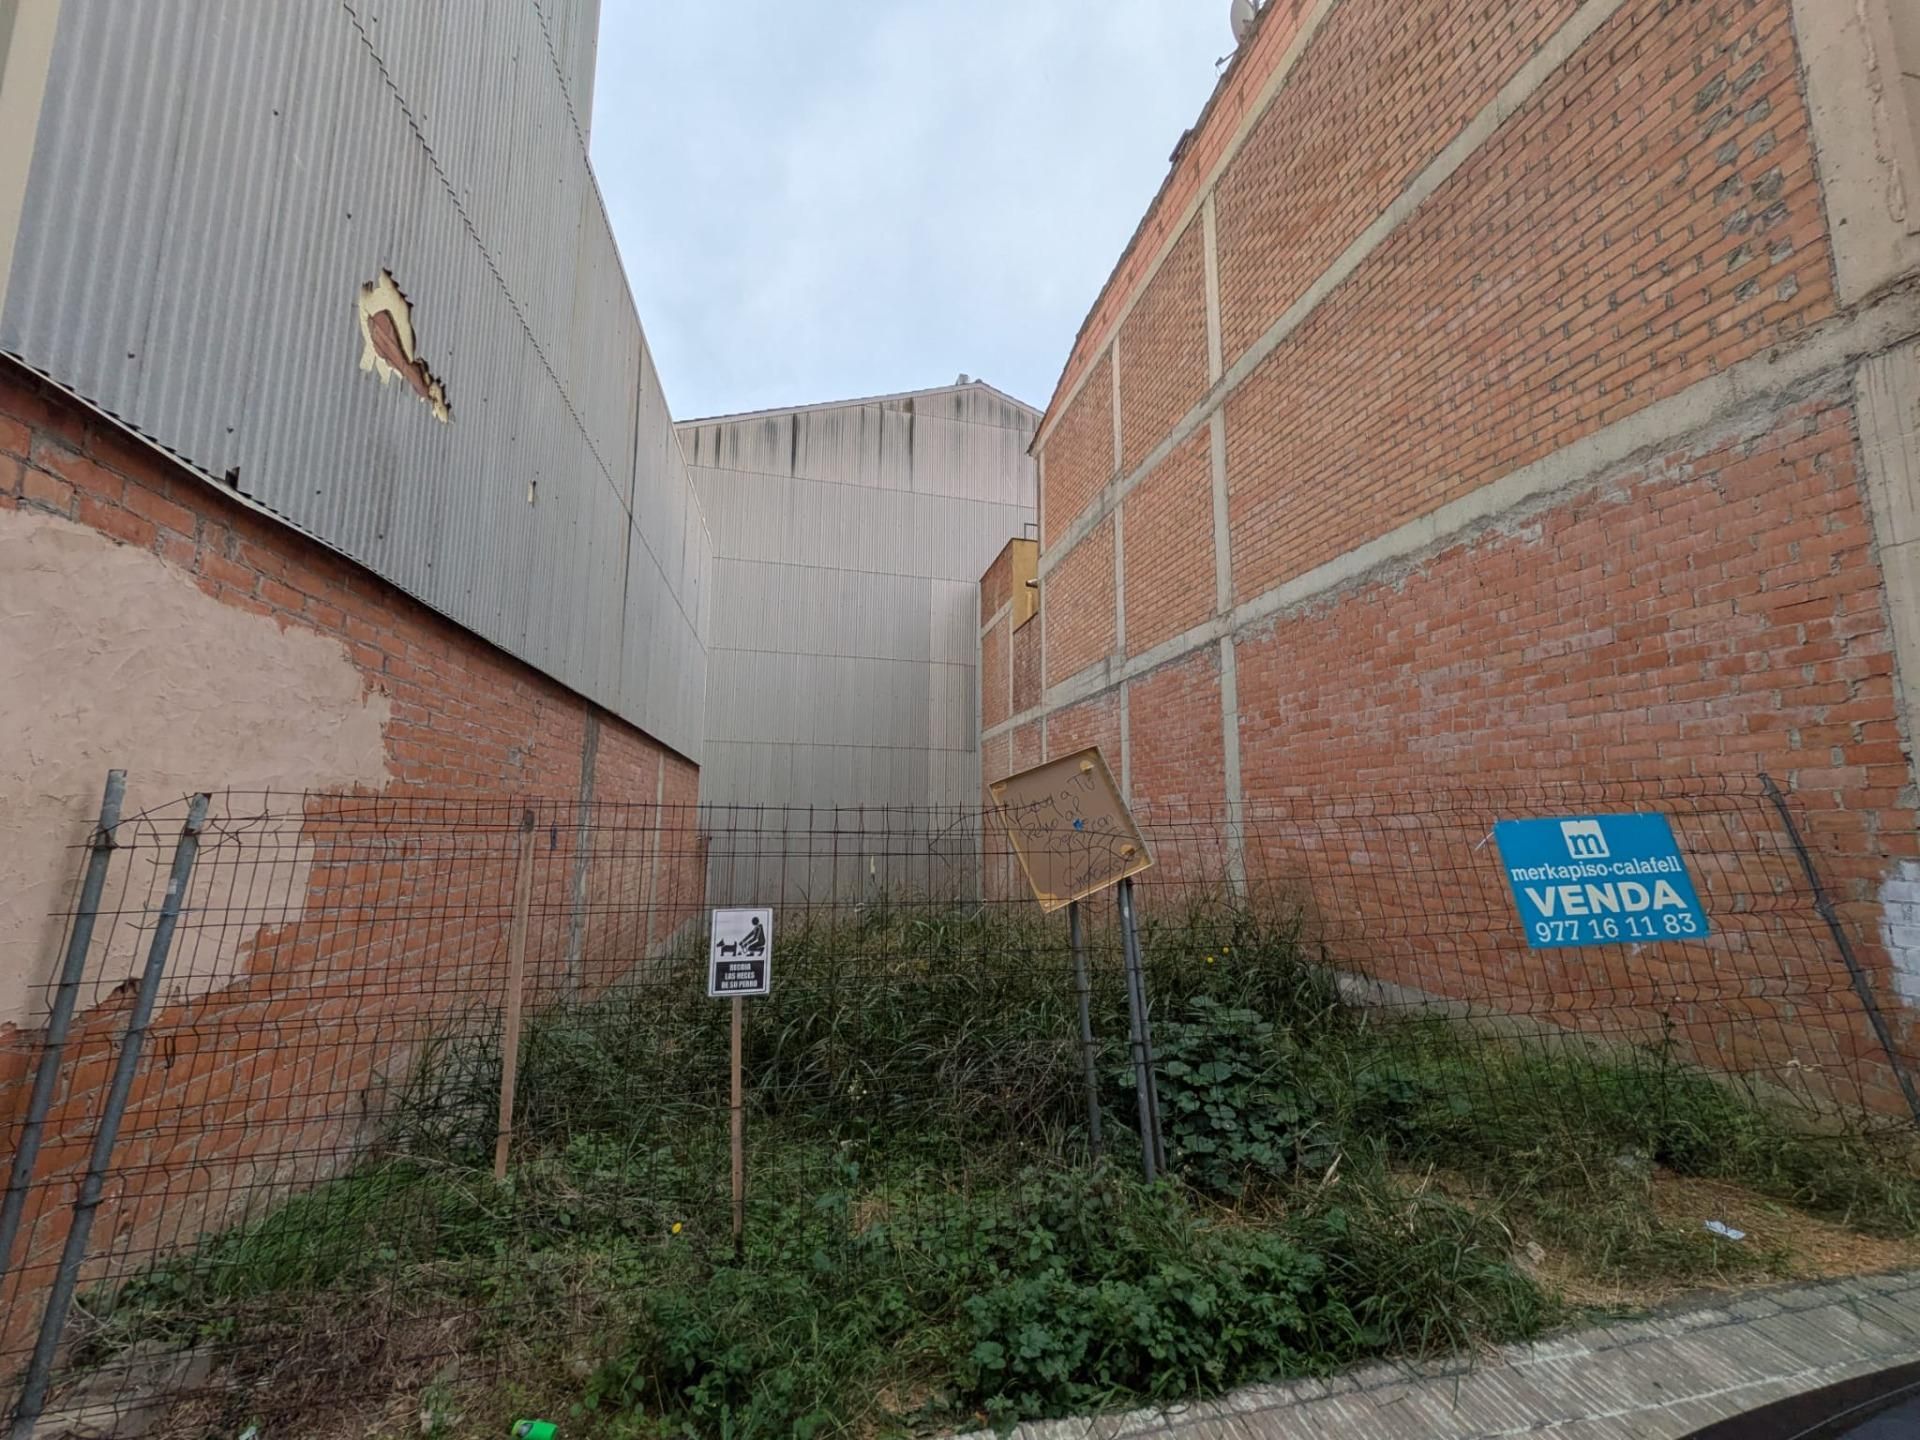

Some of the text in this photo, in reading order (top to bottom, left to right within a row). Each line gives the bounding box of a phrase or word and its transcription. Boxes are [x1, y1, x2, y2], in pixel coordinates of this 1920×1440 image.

[1525, 880, 1688, 917] VENDA
[1536, 913, 1697, 942] 977 16 11 83
[724, 972, 736, 980] LAS
